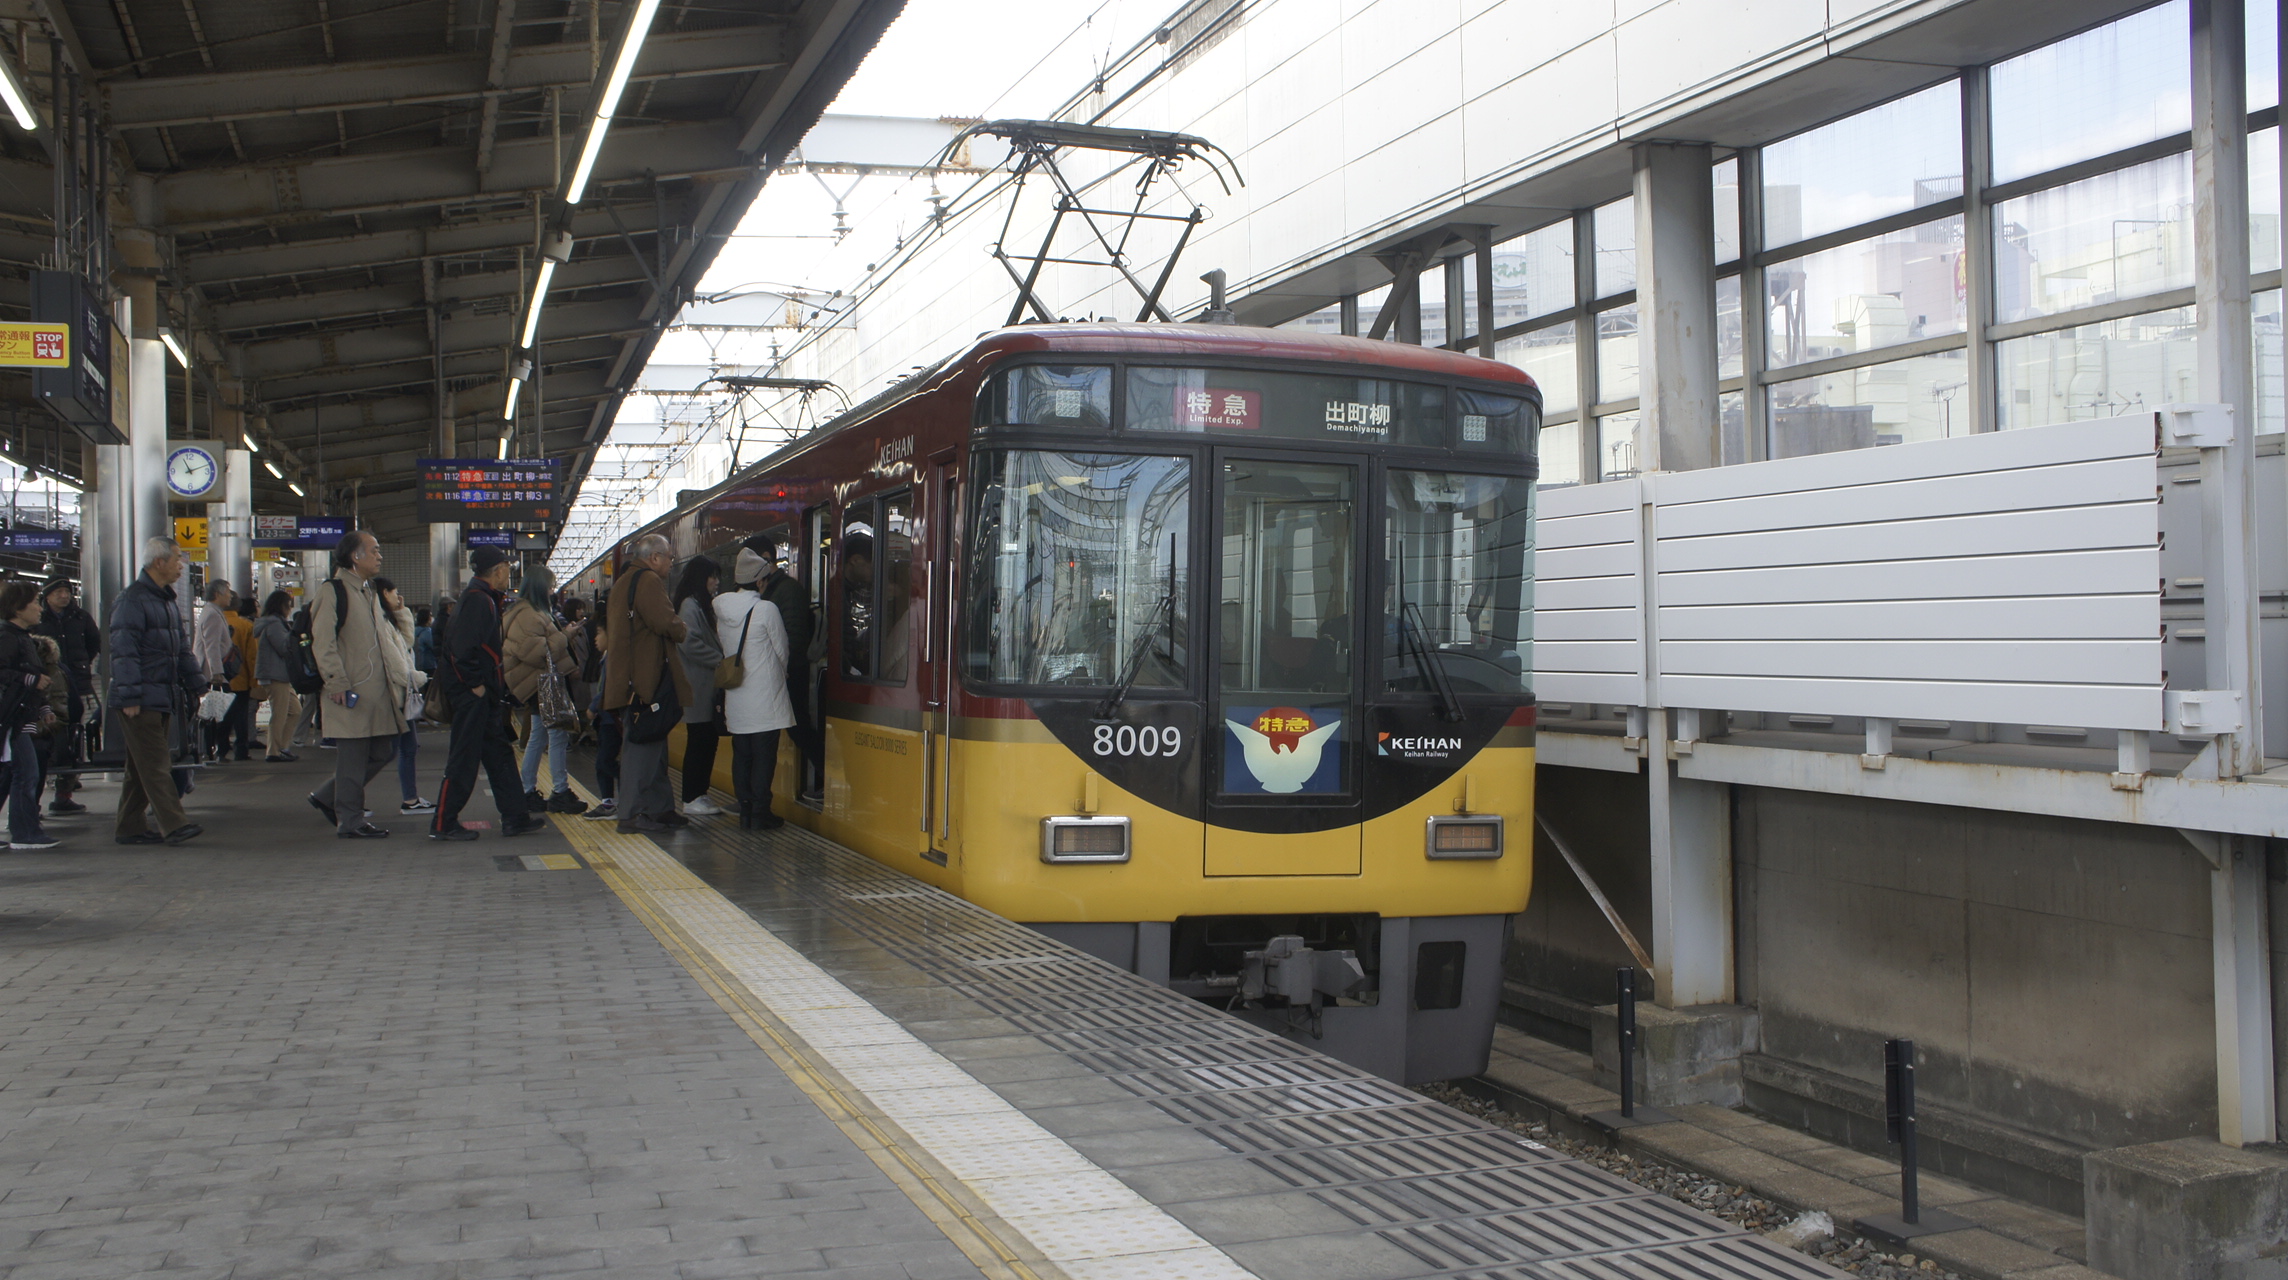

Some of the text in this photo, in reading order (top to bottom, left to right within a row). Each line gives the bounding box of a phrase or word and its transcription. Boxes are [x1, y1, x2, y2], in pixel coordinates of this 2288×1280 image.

[35, 333, 62, 342] STOP
[1187, 391, 1247, 416] 特急
[1325, 401, 1390, 426] 出町柳
[1189, 414, 1244, 426] Limited Exp.
[1326, 423, 1389, 436] Demachiyanagi
[880, 434, 914, 465] KEIHAN
[170, 467, 175, 475] 9
[204, 467, 210, 475] 3
[444, 472, 460, 481] 11:12
[462, 472, 482, 481] 特急
[502, 472, 535, 481] 出町柳
[444, 492, 460, 500] 11:16
[462, 491, 482, 500] 準急
[502, 491, 535, 501] 出町柳
[260, 517, 294, 525] ライナー
[4, 536, 11, 546] 2
[1259, 717, 1310, 732] 特急
[1093, 725, 1181, 757] 8009
[1391, 736, 1462, 750] KEIHAN
[1426, 751, 1449, 759] Railway
